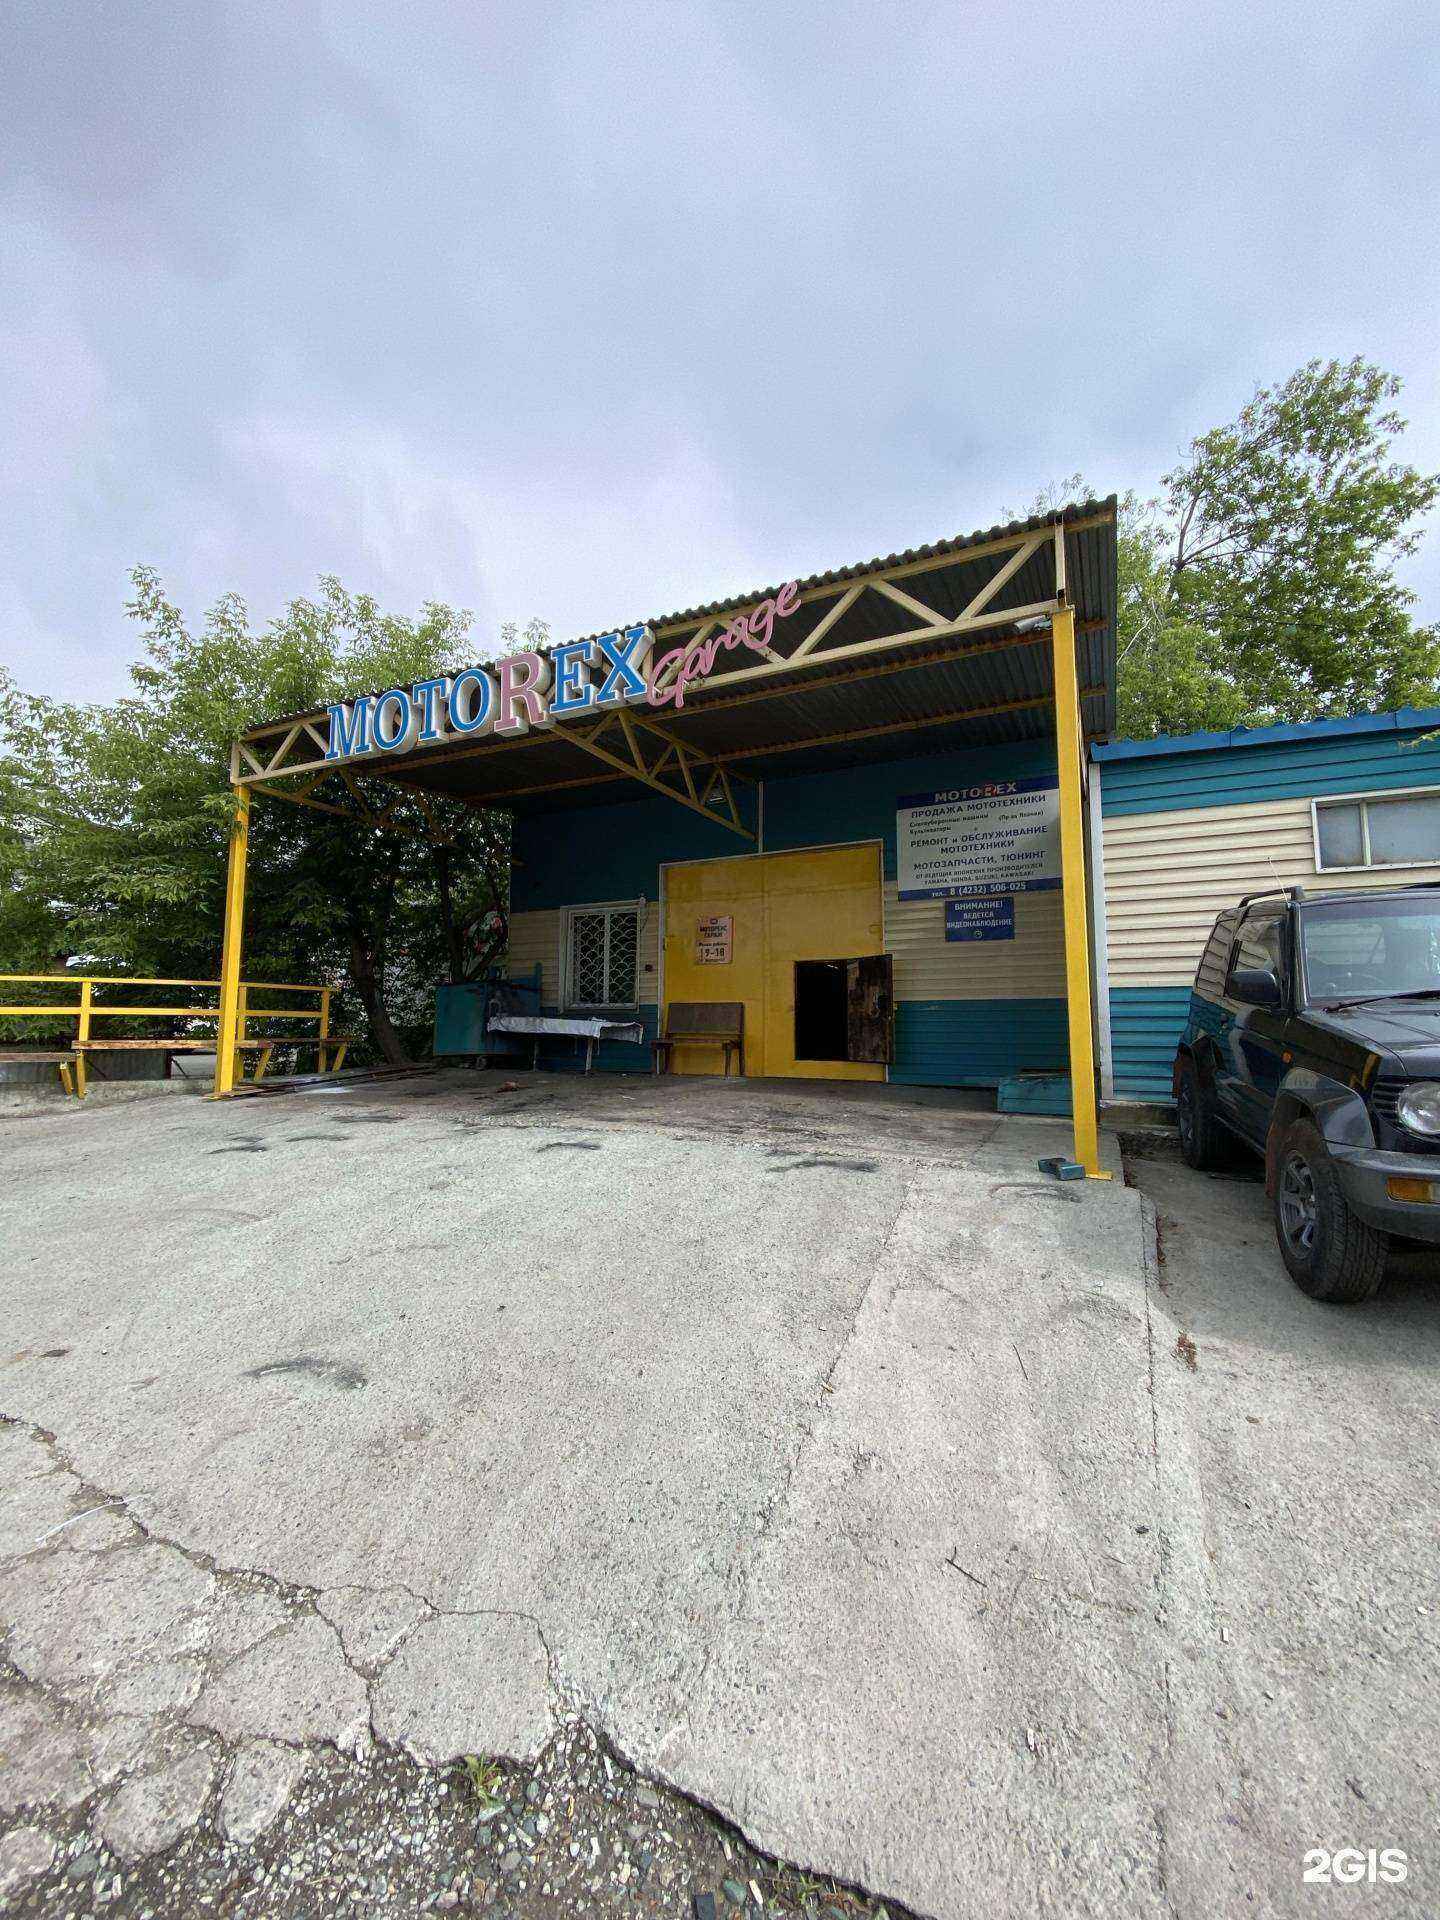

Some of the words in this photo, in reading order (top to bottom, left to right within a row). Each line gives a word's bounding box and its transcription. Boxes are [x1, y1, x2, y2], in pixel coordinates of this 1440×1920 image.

[324, 625, 655, 761] MOTOREX
[646, 579, 803, 709] Garage
[934, 782, 1017, 802] MOTOREX
[911, 805, 963, 819] ПРОДАЖА
[967, 794, 1046, 812] МОТОТЕХНИКИ
[910, 837, 949, 848] РЕМОНТ
[961, 825, 1048, 843] ОБСЛУЖИВАНИЕ
[940, 840, 1015, 855] МОТОТЕХНИКИ
[913, 855, 997, 871] МОТОЗАПЧАСТИ,
[1001, 850, 1047, 862] ТЮНИНГ
[950, 887, 956, 896] 8
[958, 884, 987, 896] (4232)
[954, 900, 1003, 912] ВНИМАНИЕ!
[946, 918, 1013, 930] ВИДЕОНАБЛЮДЕНИЕ
[963, 911, 994, 920] ВЕДЕТСЯ
